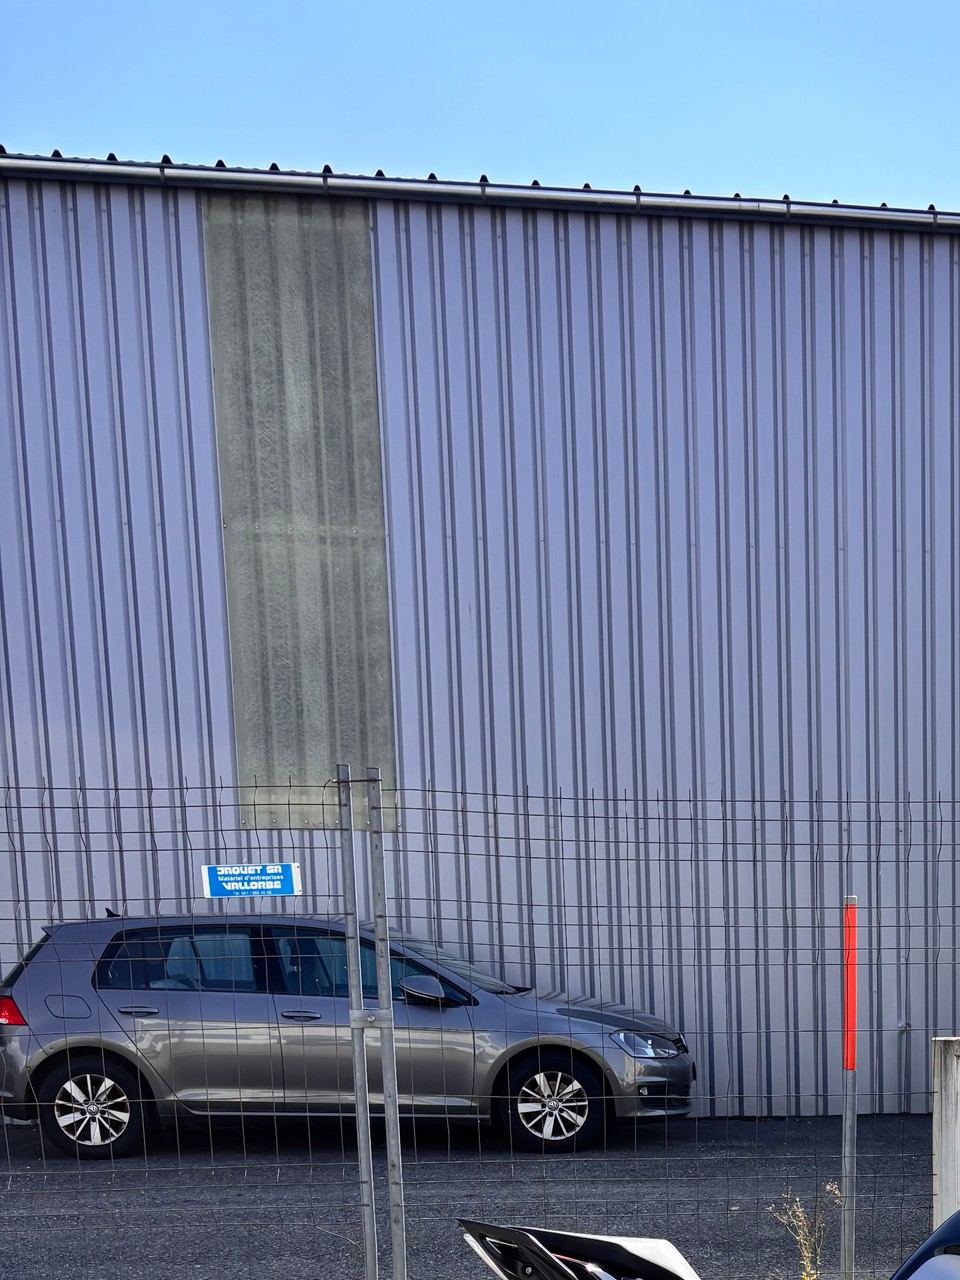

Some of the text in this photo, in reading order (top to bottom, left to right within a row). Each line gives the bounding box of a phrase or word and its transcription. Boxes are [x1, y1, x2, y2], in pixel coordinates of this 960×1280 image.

[216, 865, 283, 875] JAQUET SA
[222, 881, 282, 890] VALLORBE
